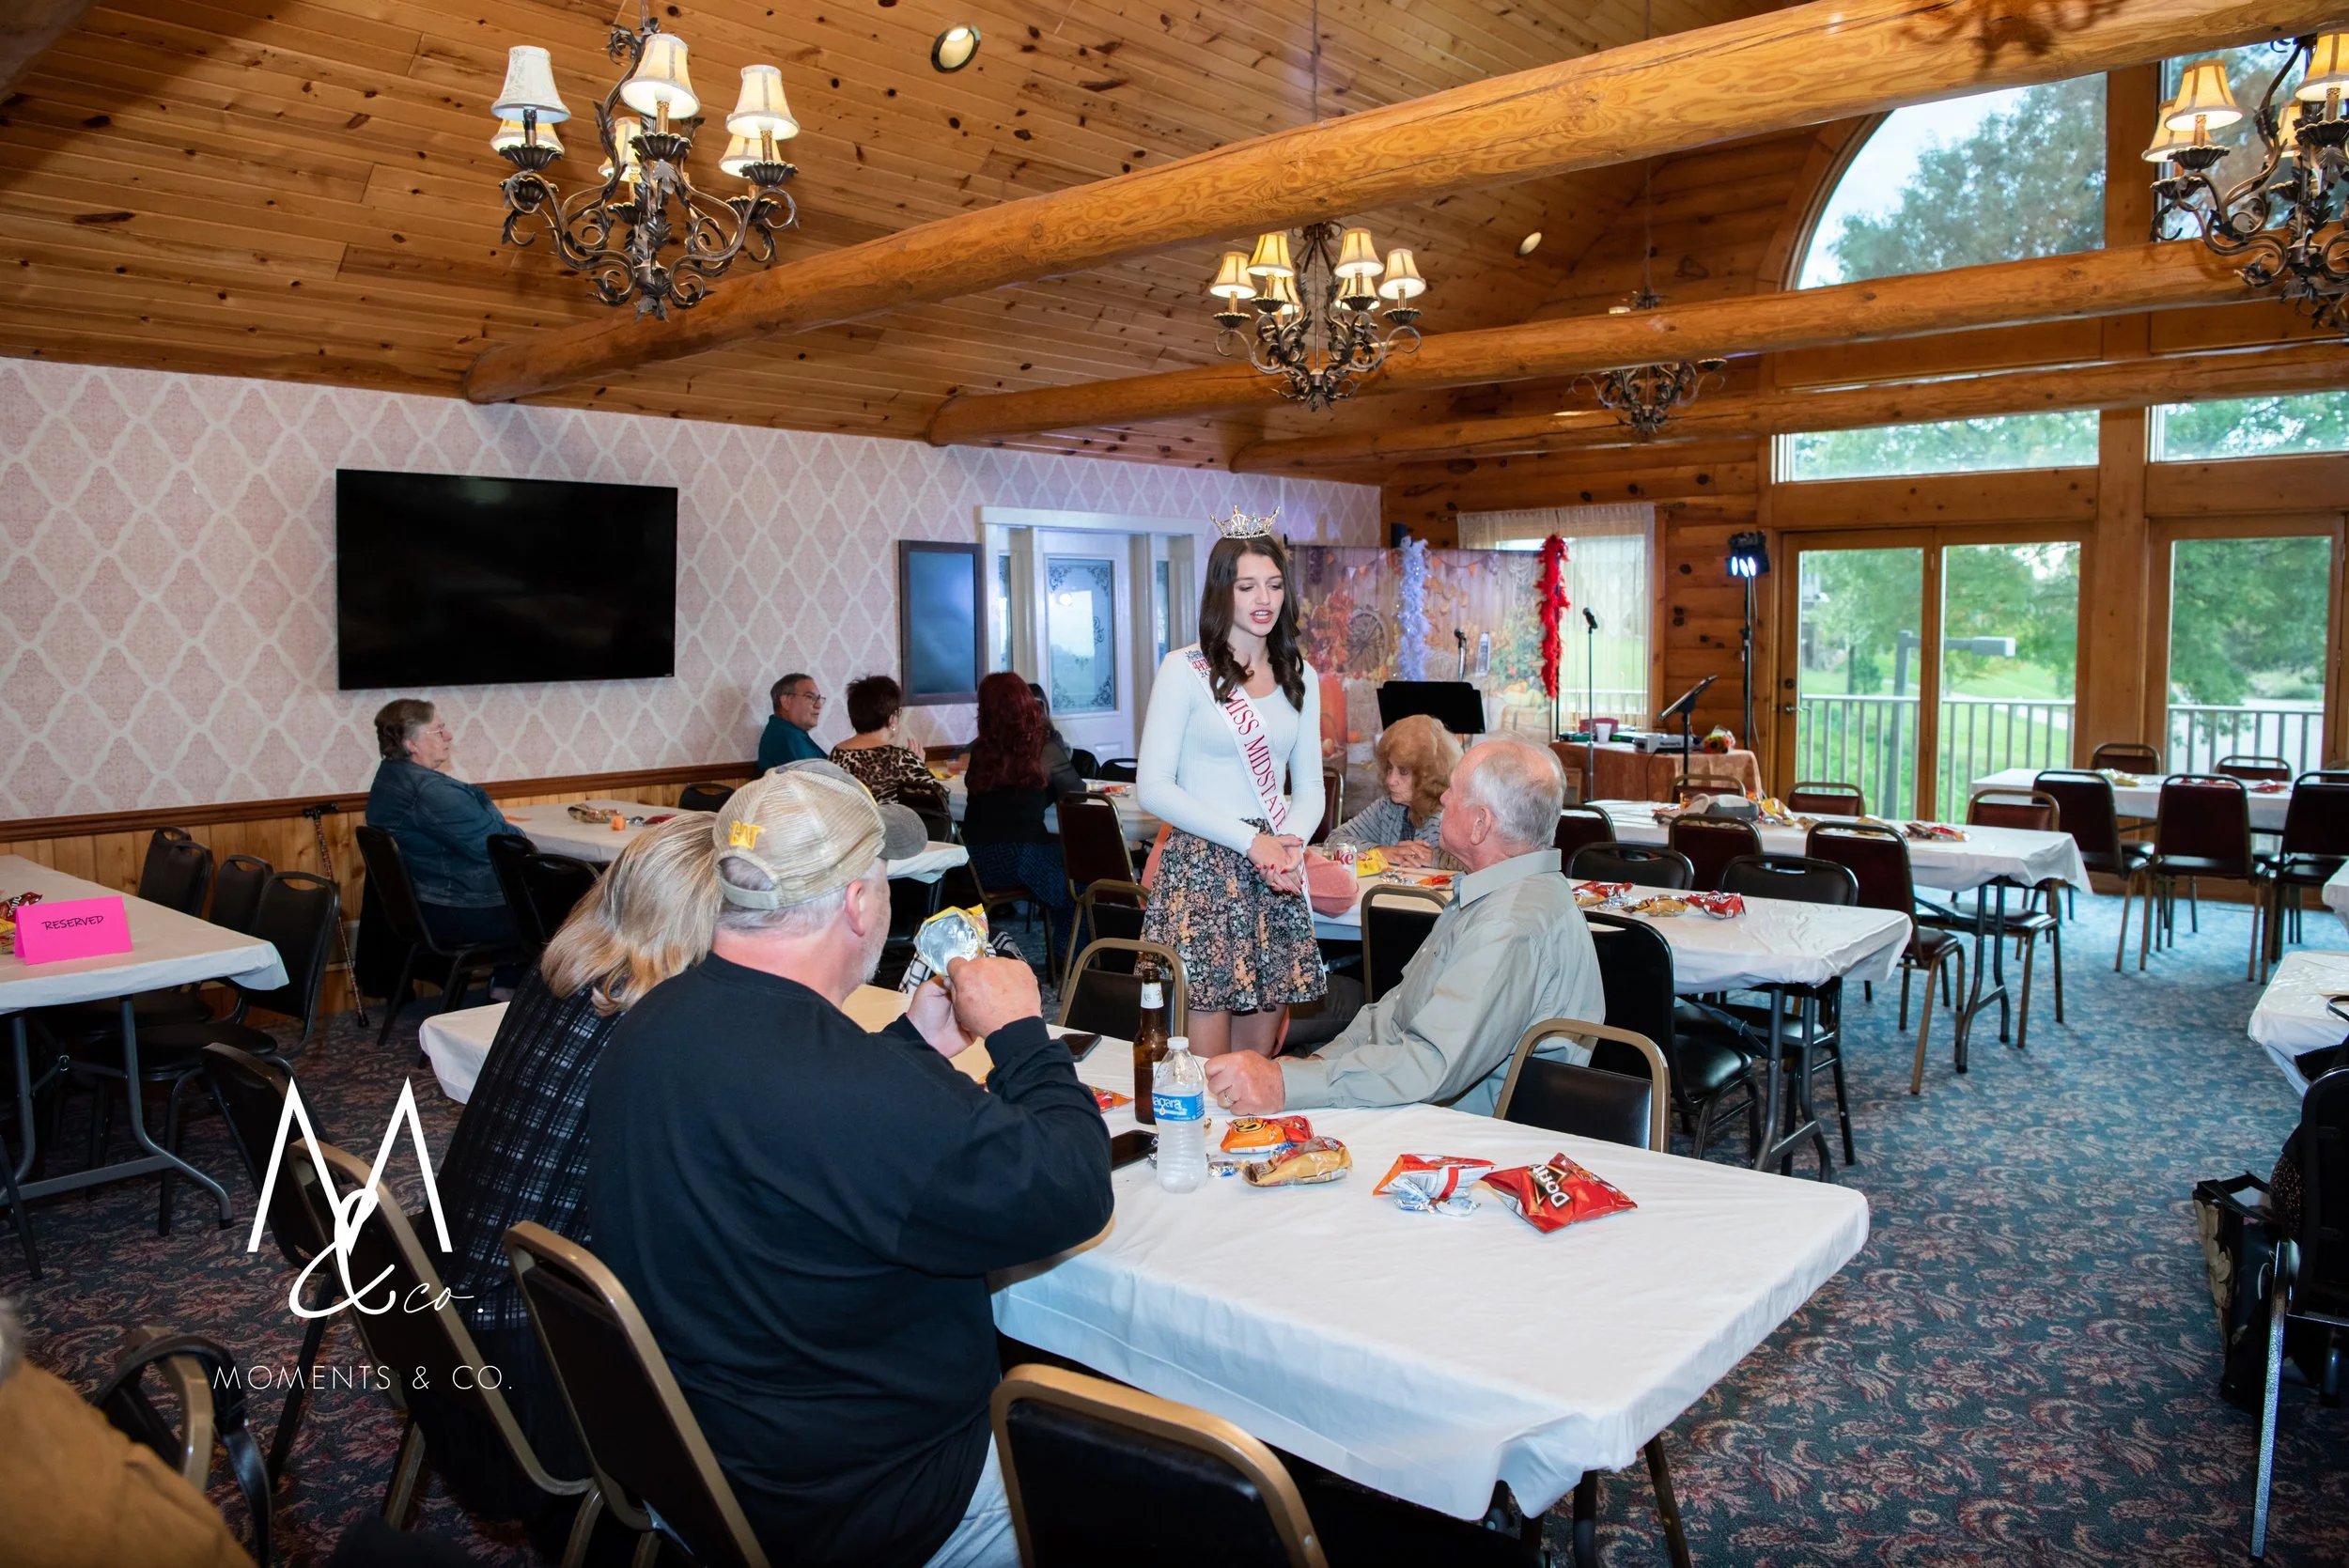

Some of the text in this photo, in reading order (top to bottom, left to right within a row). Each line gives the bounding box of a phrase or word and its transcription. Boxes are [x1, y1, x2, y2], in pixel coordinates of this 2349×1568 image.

[1225, 688, 1260, 736] MISS
[729, 820, 760, 849] CAT
[41, 915, 104, 930] RESERVED
